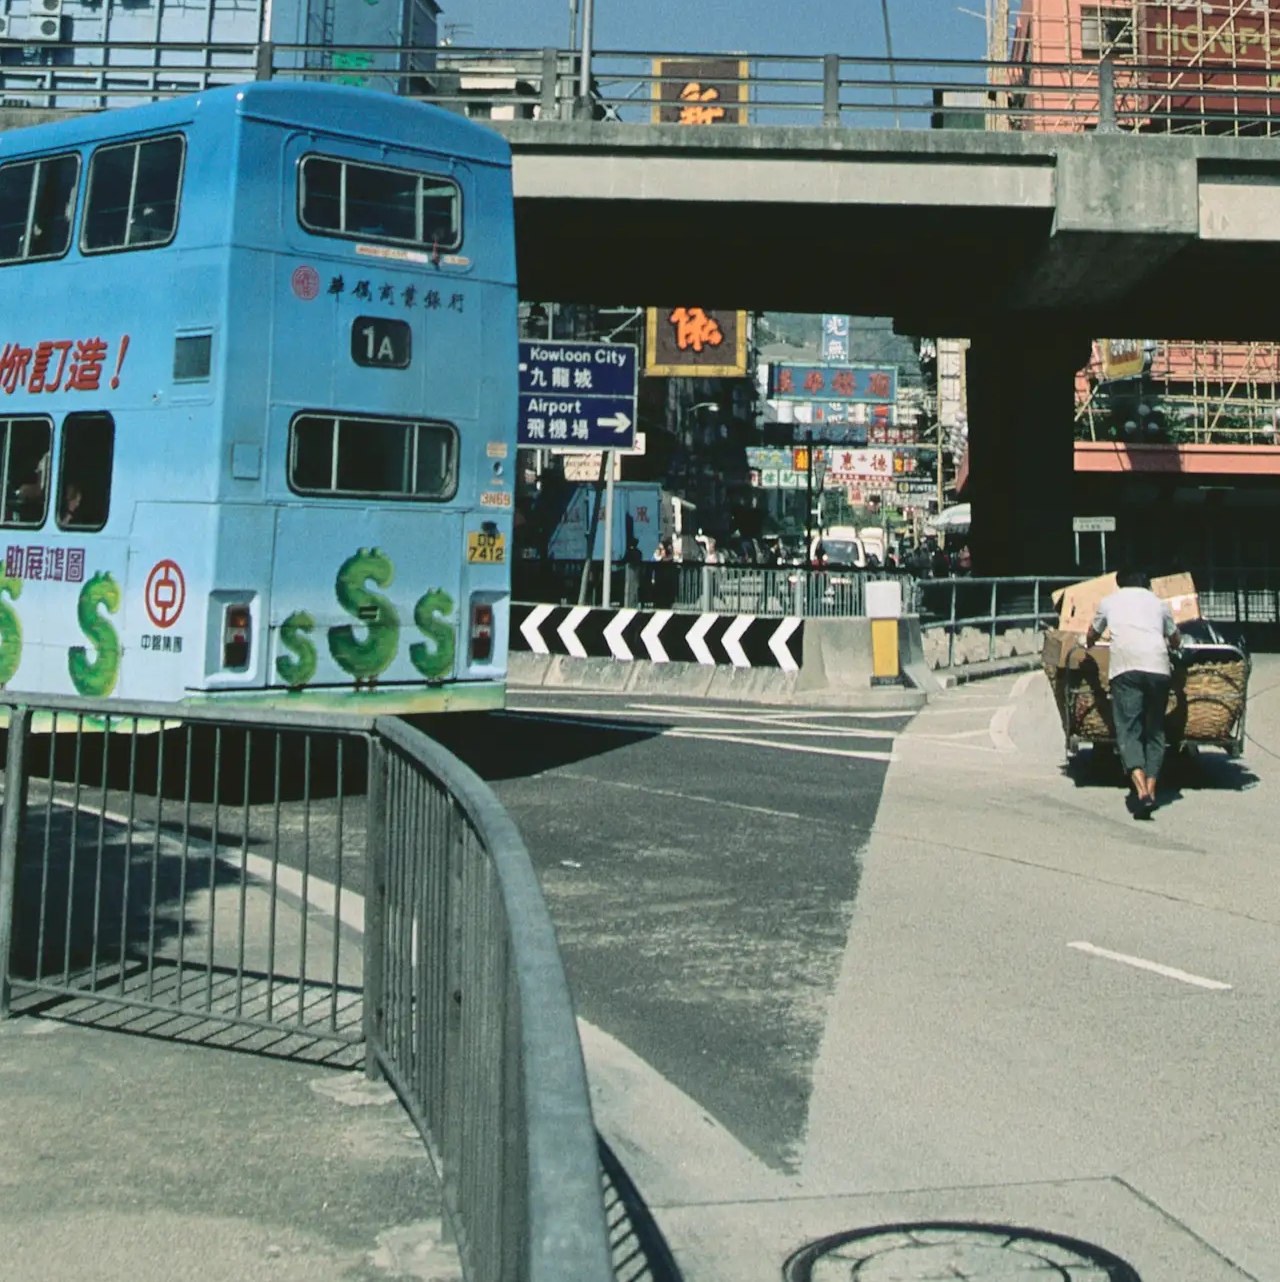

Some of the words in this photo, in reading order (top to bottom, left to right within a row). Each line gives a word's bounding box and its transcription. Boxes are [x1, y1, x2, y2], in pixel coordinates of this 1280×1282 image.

[362, 325, 394, 361] 1A
[530, 347, 592, 363] Kowloon
[594, 349, 627, 367] City
[530, 366, 593, 389] 九龍城
[527, 398, 582, 417] Airport
[527, 418, 589, 440] 飛機場
[481, 492, 512, 506] 3N69
[468, 546, 504, 561] 7412
